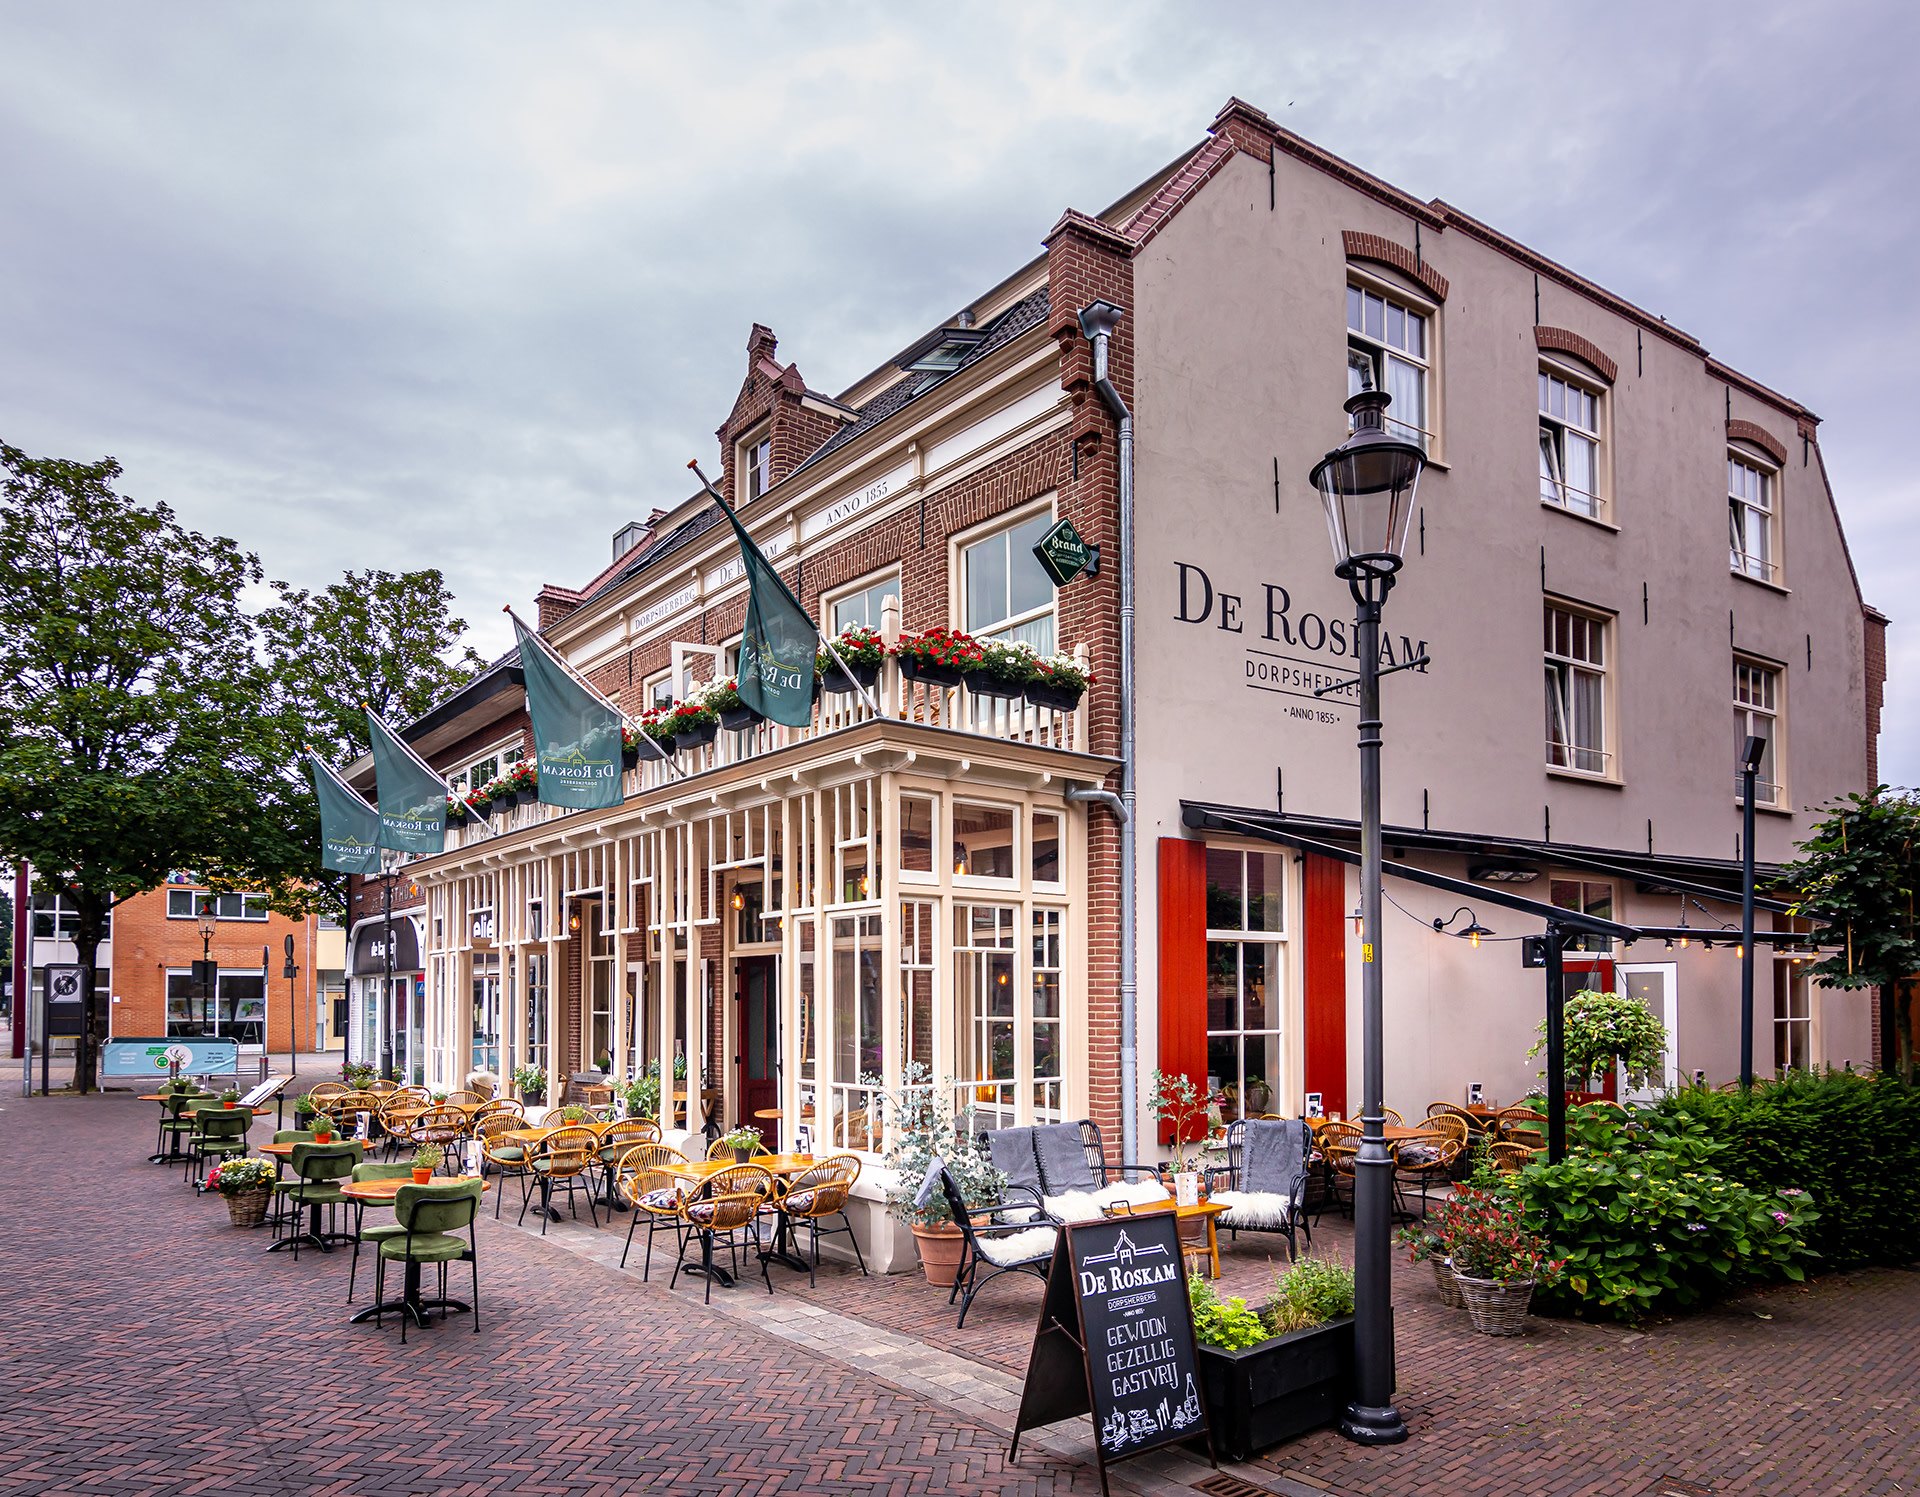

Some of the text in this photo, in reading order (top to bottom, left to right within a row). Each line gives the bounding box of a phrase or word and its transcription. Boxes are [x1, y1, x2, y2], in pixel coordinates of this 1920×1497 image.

[826, 481, 888, 525] ANNO 1855
[1051, 535, 1084, 554] Brand
[720, 543, 778, 584] DE RAM
[635, 588, 695, 630] DORPSHERBERG
[1173, 561, 1243, 634] DE
[1290, 707, 1335, 724] ANNO 1855
[1080, 1263, 1177, 1297] DE ROSKAM
[1107, 1293, 1157, 1309] DORPSHERBERG
[1106, 1316, 1167, 1347] GEWOON
[1106, 1338, 1176, 1373] GEZELLIG
[1112, 1362, 1179, 1397] GASTVRIJ
